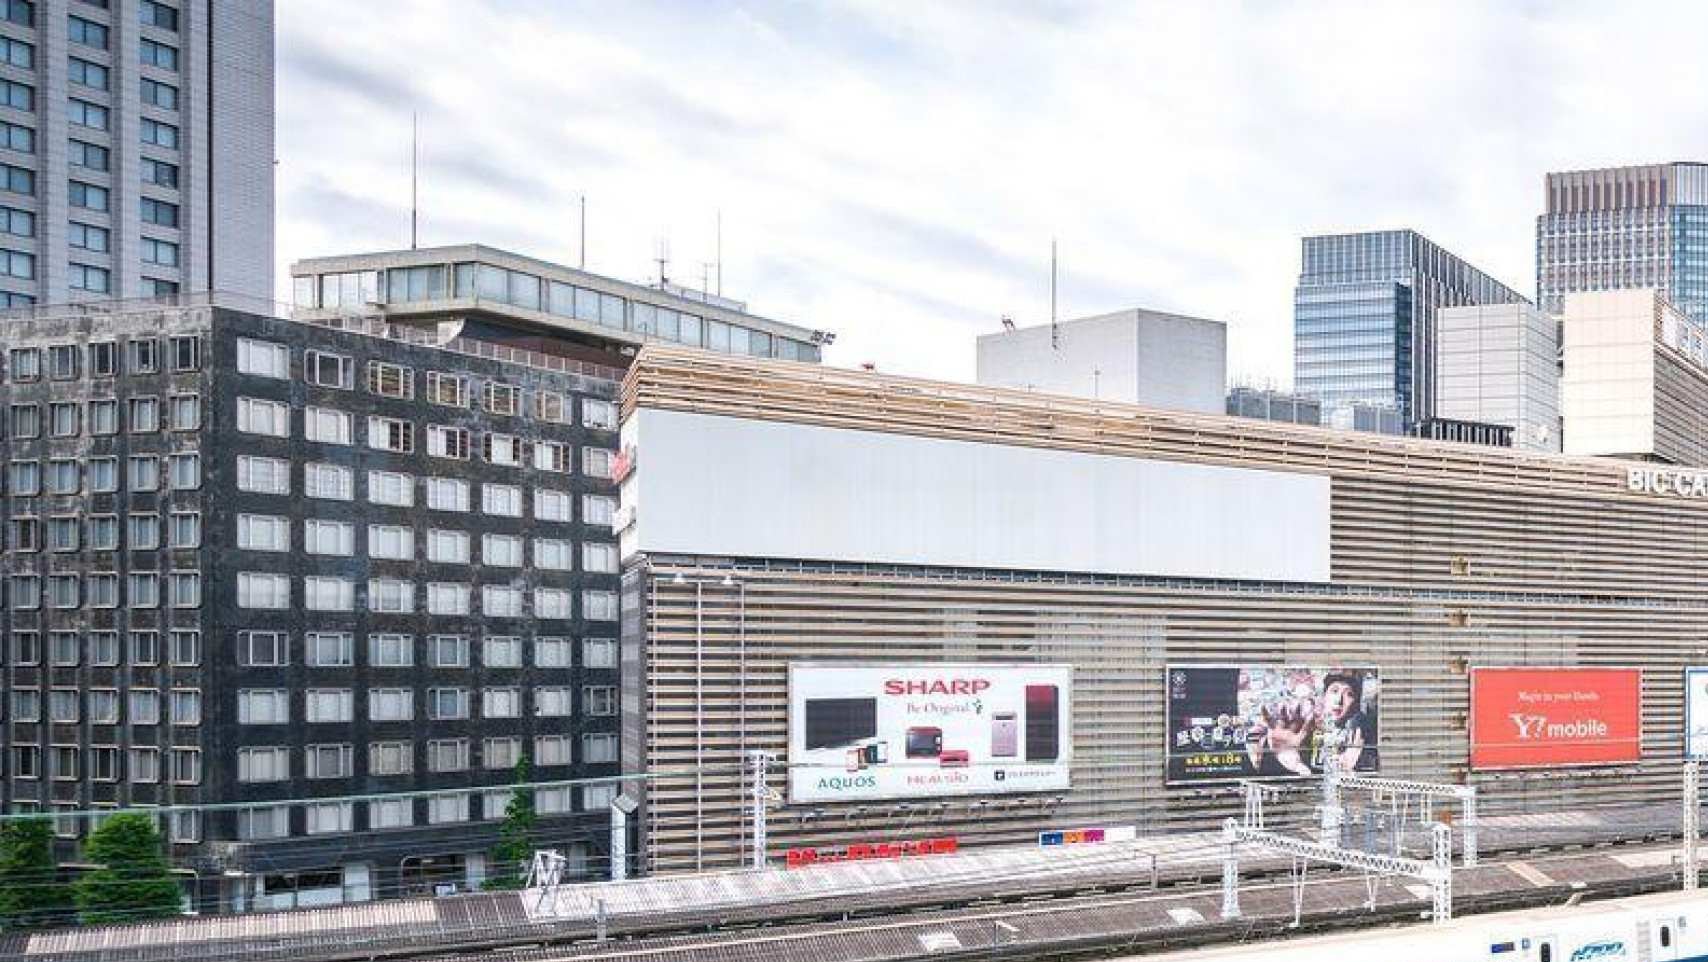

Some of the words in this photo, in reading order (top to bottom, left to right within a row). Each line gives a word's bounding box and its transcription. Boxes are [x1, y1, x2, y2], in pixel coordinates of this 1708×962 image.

[1627, 467, 1666, 492] BIC
[884, 679, 990, 695] SHARP
[818, 776, 876, 789] AQUOS
